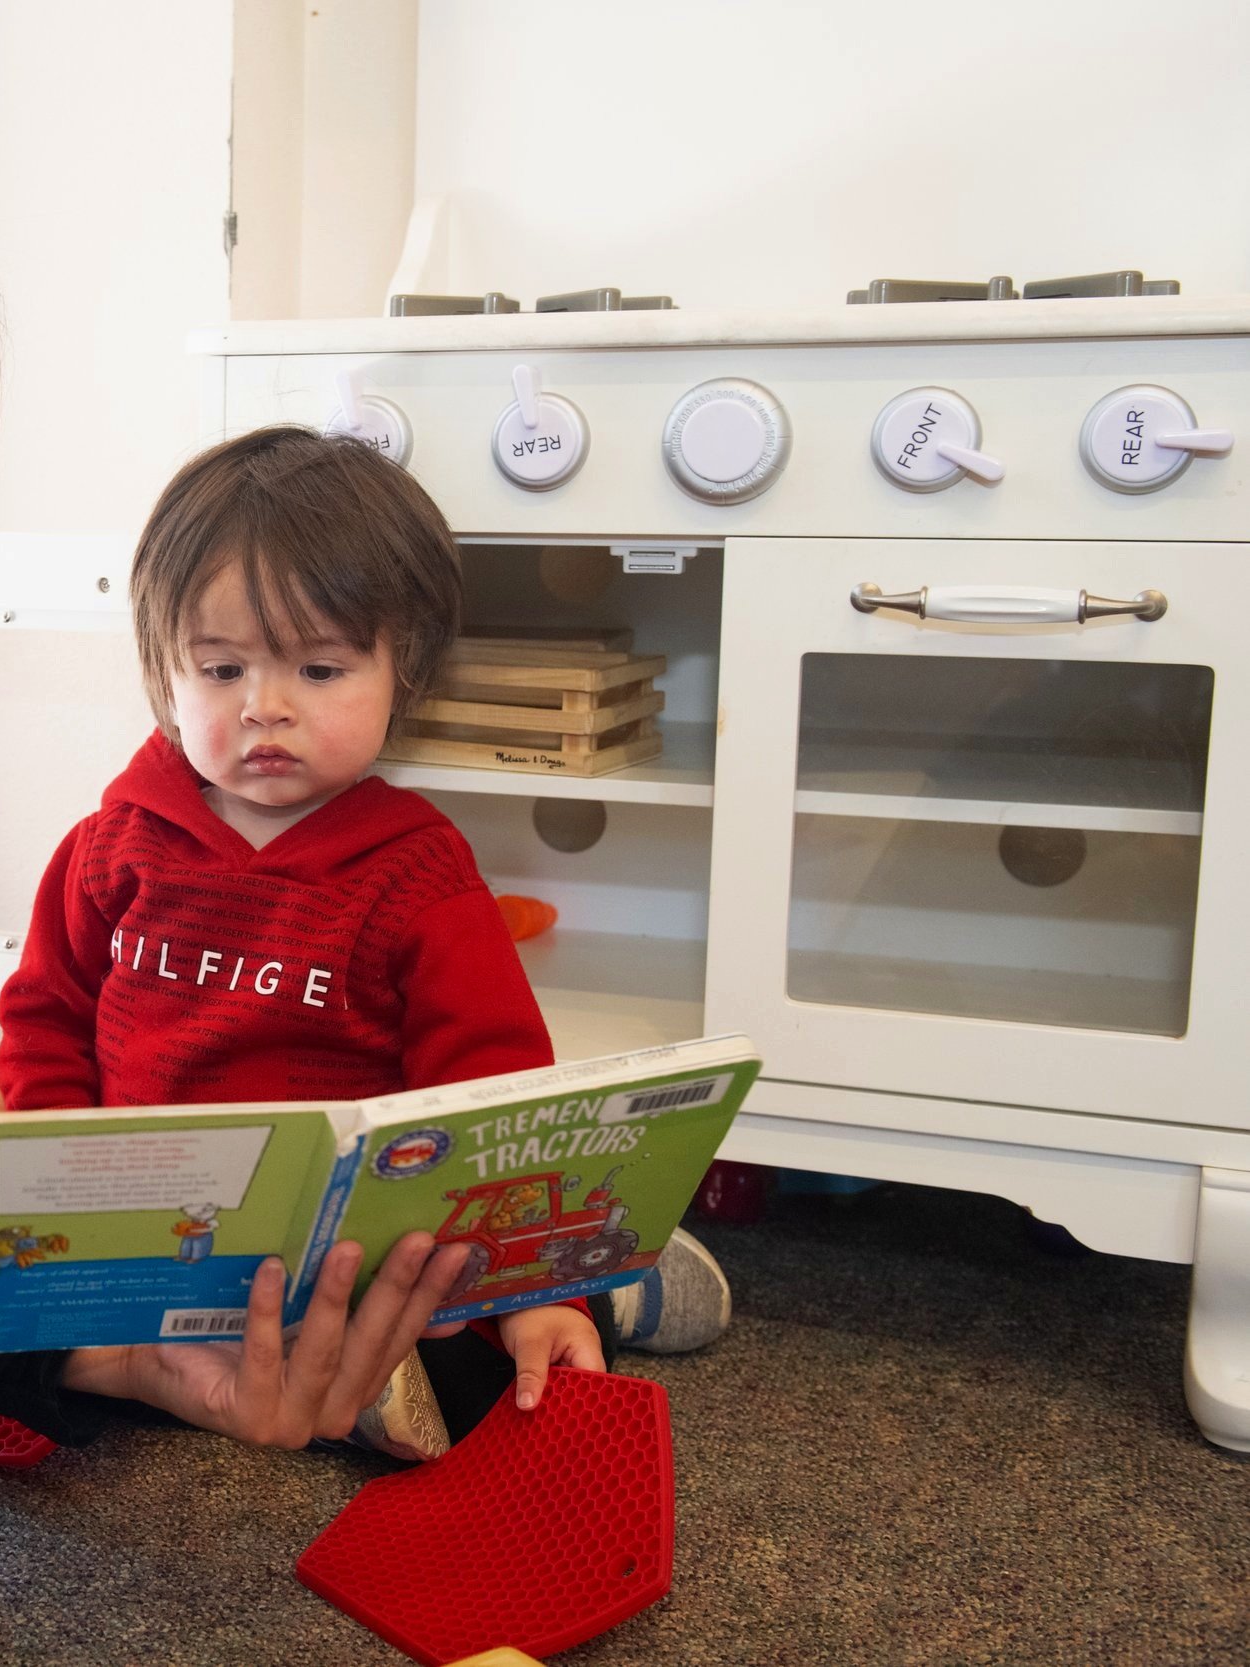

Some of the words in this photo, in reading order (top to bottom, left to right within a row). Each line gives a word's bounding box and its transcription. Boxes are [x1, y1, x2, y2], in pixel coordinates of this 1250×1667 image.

[512, 435, 562, 457] REAR
[897, 402, 943, 469] FRONT
[1121, 409, 1145, 465] REAR
[495, 751, 530, 764] Melissa
[111, 929, 348, 1010] HILFIGE
[466, 1095, 604, 1146] TREMEN
[464, 1125, 646, 1179] TRACTORS
[510, 1292, 542, 1305] Ant
[551, 1278, 611, 1297] Parker
